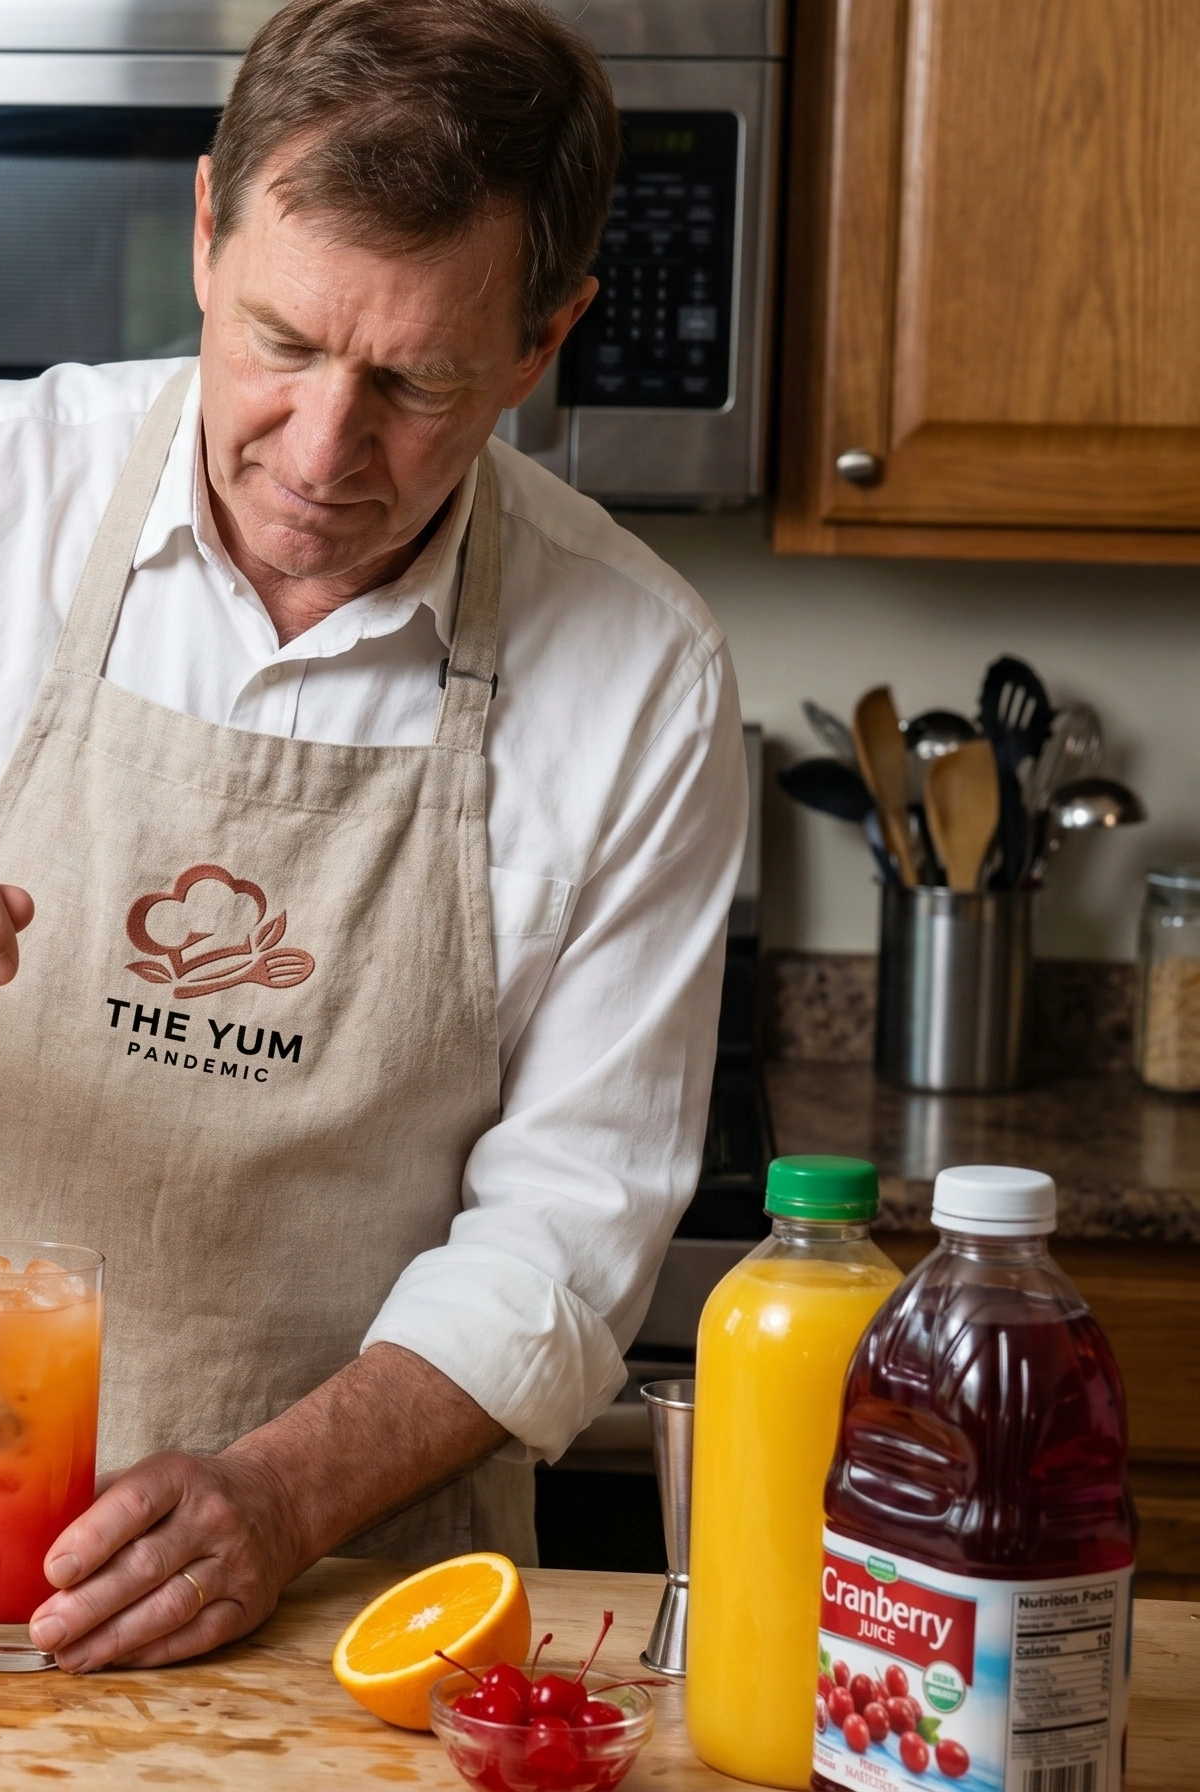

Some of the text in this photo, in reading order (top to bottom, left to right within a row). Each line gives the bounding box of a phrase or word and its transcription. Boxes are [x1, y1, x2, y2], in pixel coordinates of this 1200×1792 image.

[106, 997, 303, 1064] THE YUM
[126, 1041, 269, 1083] PANDEMIC
[822, 1565, 953, 1650] Cranberry
[1082, 1587, 1114, 1603] Facts
[856, 1618, 896, 1646] JUICE
